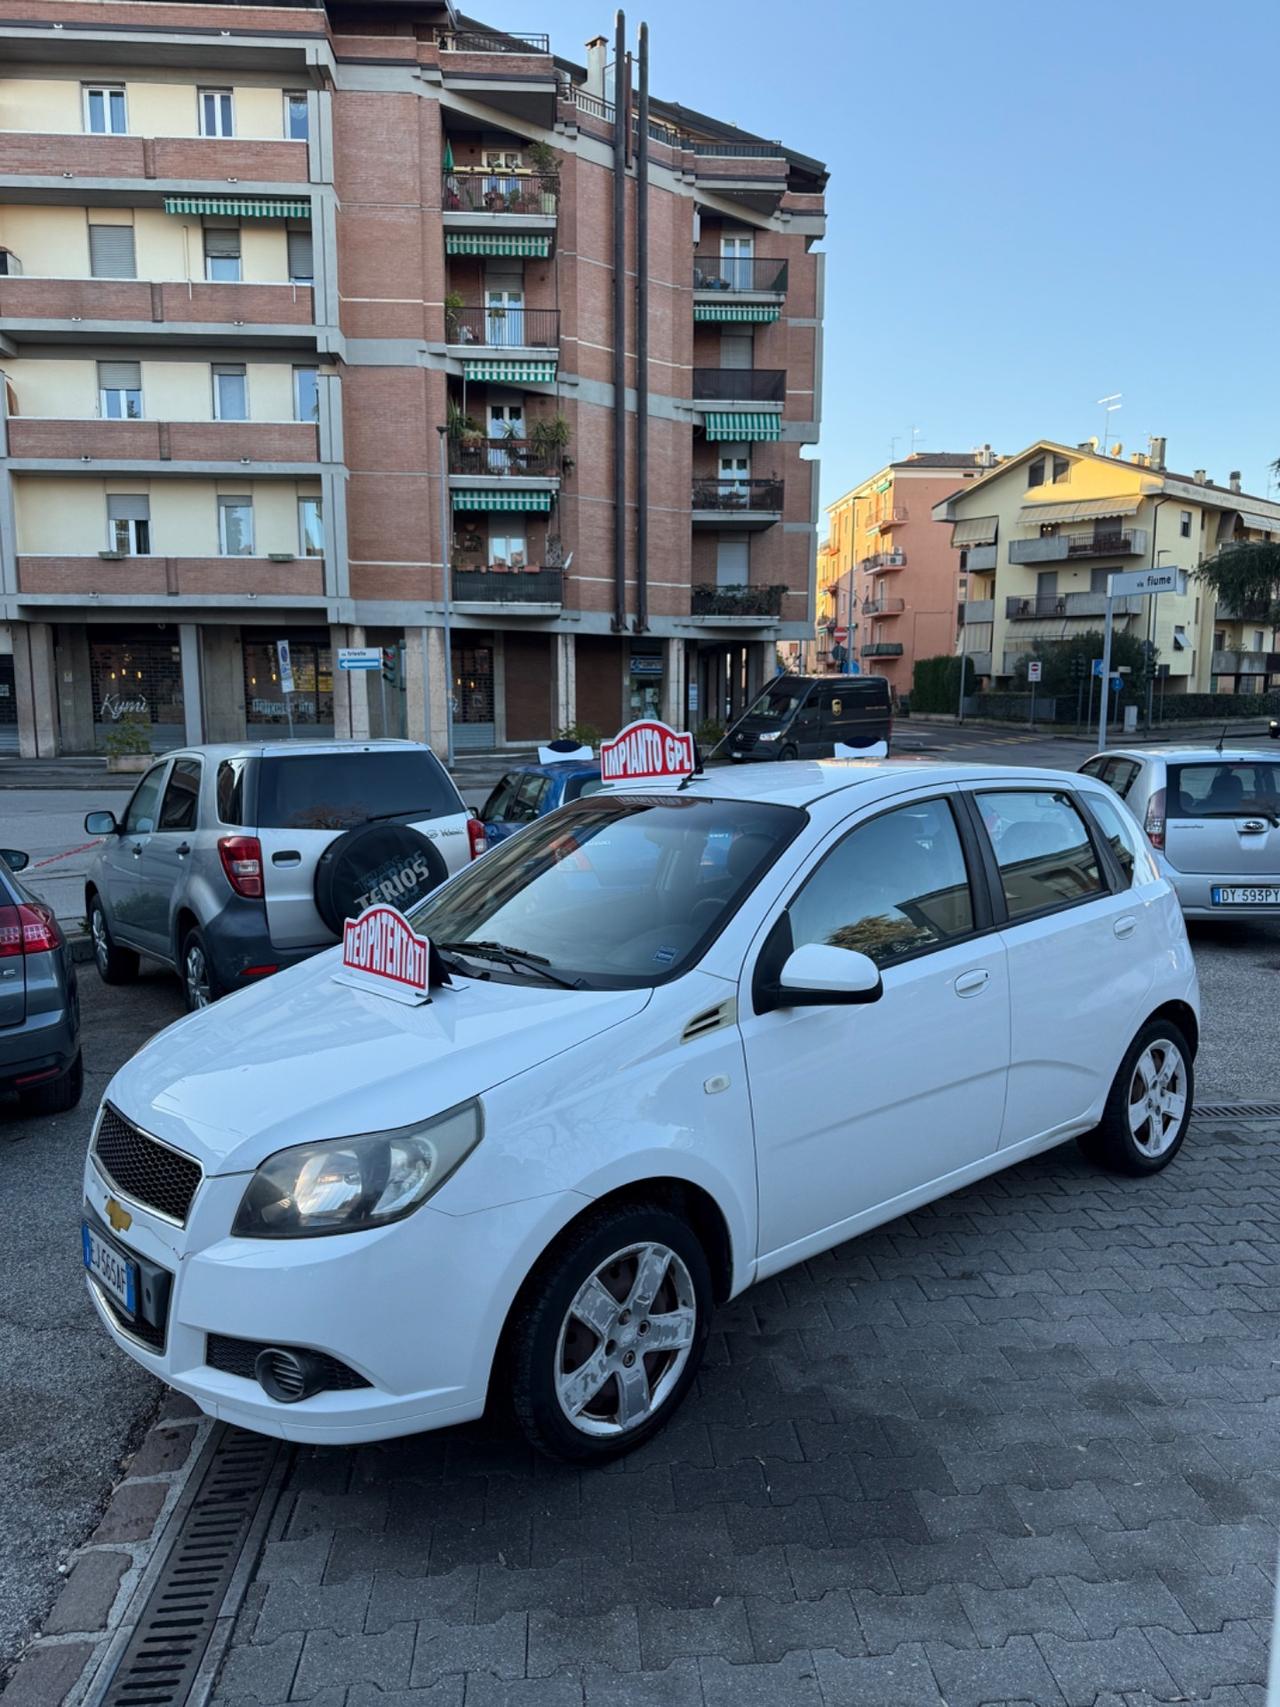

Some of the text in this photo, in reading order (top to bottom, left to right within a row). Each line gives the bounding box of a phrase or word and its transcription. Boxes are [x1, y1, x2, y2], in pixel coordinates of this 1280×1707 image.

[1147, 575, 1171, 586] fiume
[604, 728, 691, 777] IMPIANTO GPL
[353, 859, 430, 909] TERIOS
[345, 911, 425, 985] NEOPATENTATI
